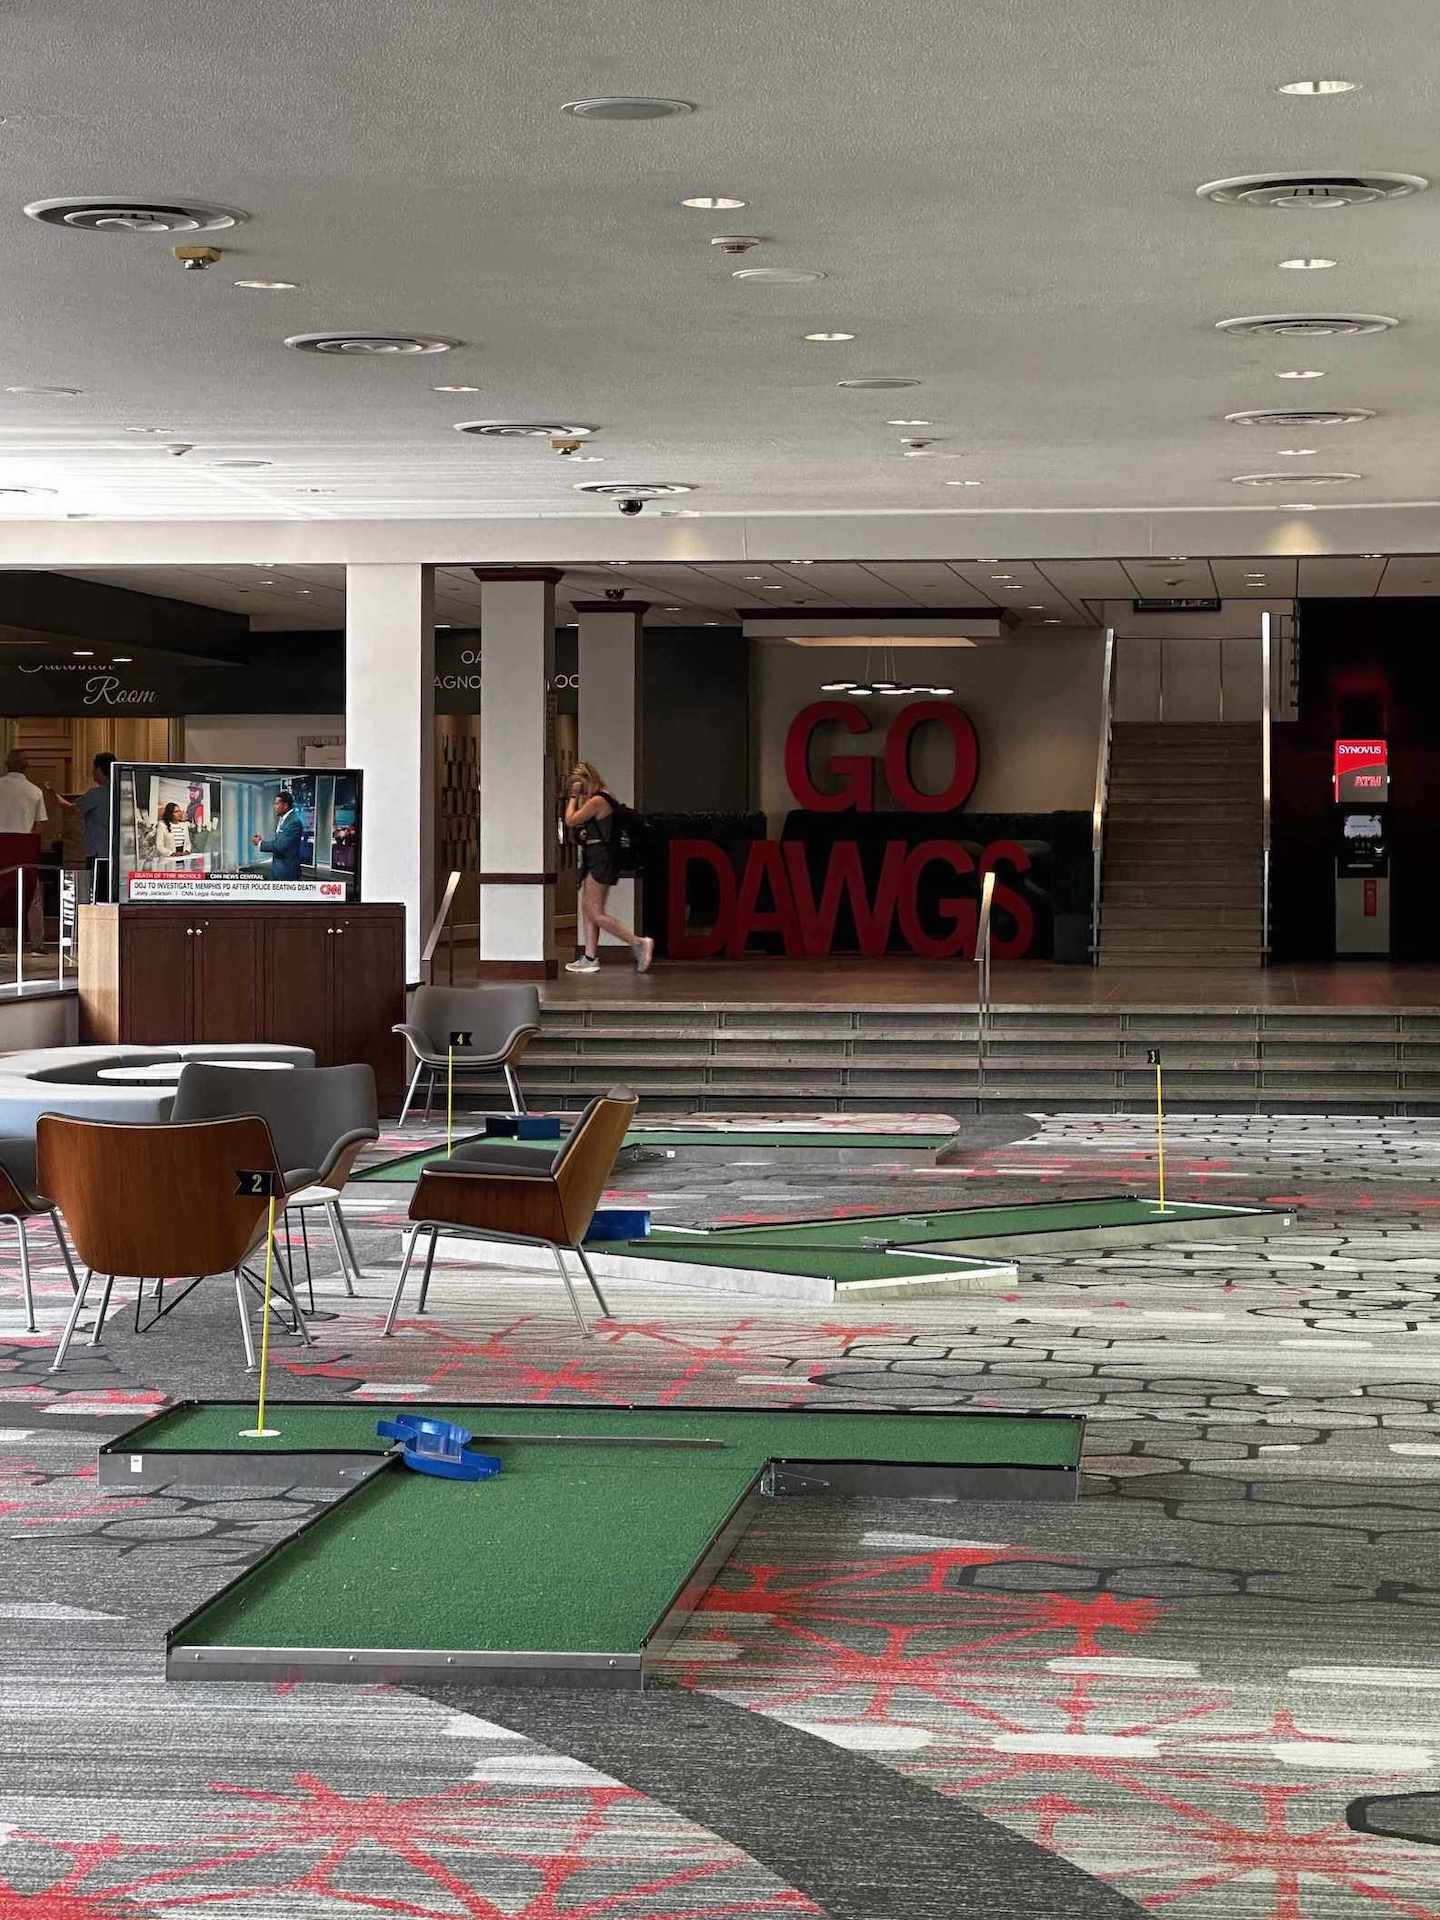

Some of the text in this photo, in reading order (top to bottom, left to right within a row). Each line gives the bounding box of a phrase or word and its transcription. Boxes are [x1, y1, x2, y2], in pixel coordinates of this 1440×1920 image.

[83, 675, 158, 705] Room
[784, 700, 980, 812] GO
[1339, 745, 1381, 754] SYNOVUS
[1354, 776, 1382, 787] ATM
[320, 884, 342, 895] CNN
[666, 840, 1034, 960] DAWGS
[457, 1033, 464, 1045] 4
[252, 1174, 263, 1193] 2
